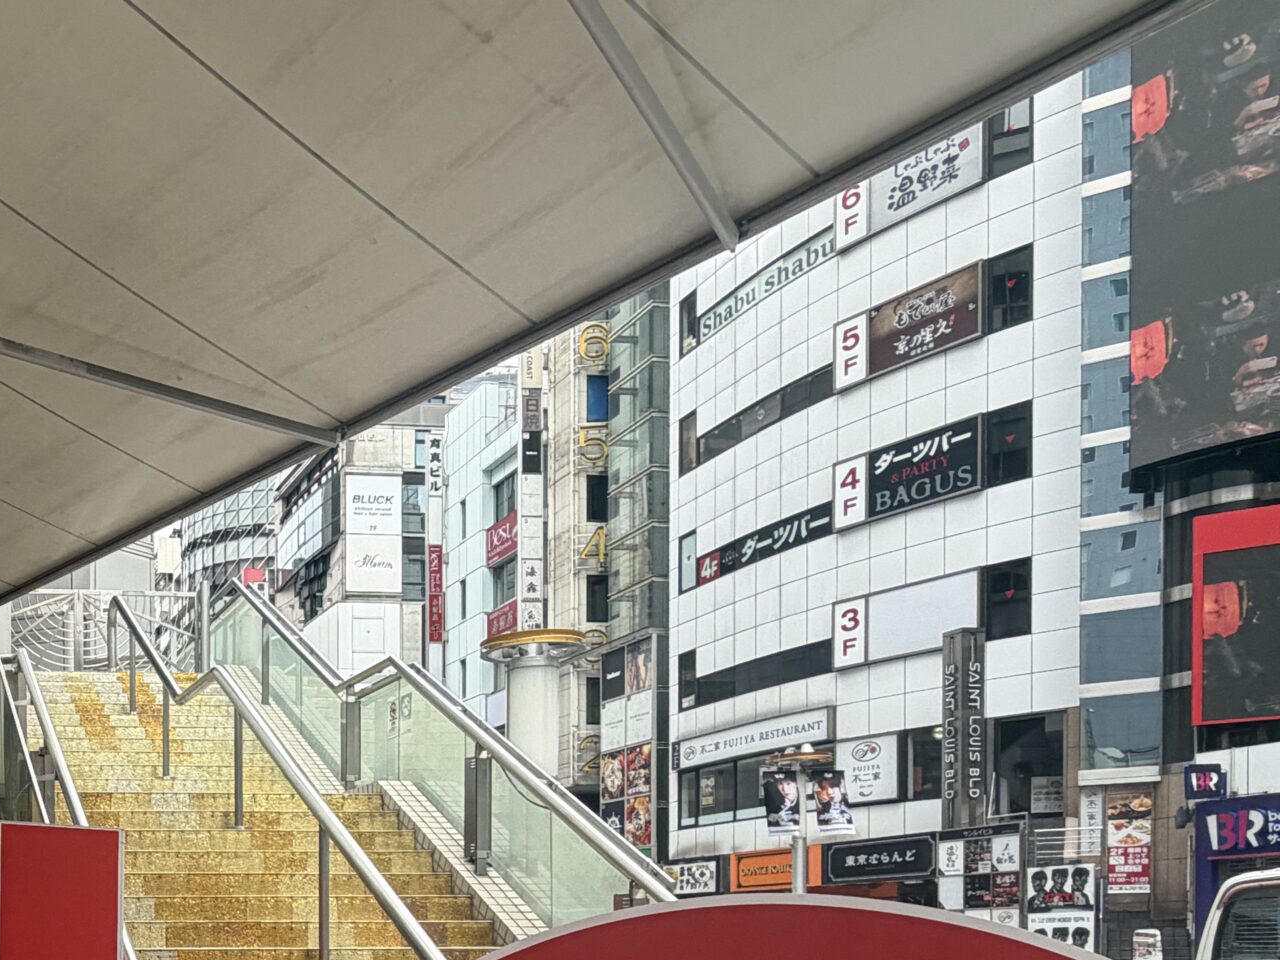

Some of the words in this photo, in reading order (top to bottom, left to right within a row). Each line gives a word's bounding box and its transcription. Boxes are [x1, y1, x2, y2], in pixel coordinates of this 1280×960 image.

[888, 153, 960, 212] 温野菜
[701, 286, 757, 339] Shabu
[763, 236, 835, 295] shabu
[841, 324, 861, 377] 5F
[578, 423, 609, 463] 5
[873, 430, 972, 476] ダーツバー
[874, 464, 973, 513] BAGUS
[901, 455, 950, 479] PARTY
[352, 494, 394, 505] BLUCK
[839, 466, 861, 518] 4F
[740, 514, 831, 564] ダーツバー
[700, 558, 719, 580] 4F
[839, 607, 861, 658] 3F
[944, 663, 957, 712] SAINT
[967, 661, 982, 710] SAINT
[699, 741, 721, 755] 不二家
[723, 733, 756, 750] FUJIYA
[758, 720, 824, 742] RESTAURANT
[944, 717, 957, 764] LOUIS
[968, 715, 982, 763] LOUIS
[851, 771, 881, 784] 不二家
[852, 764, 881, 773] FUJIYA
[944, 768, 956, 800] BLD
[968, 767, 982, 799] BLD
[1206, 809, 1264, 851] BR
